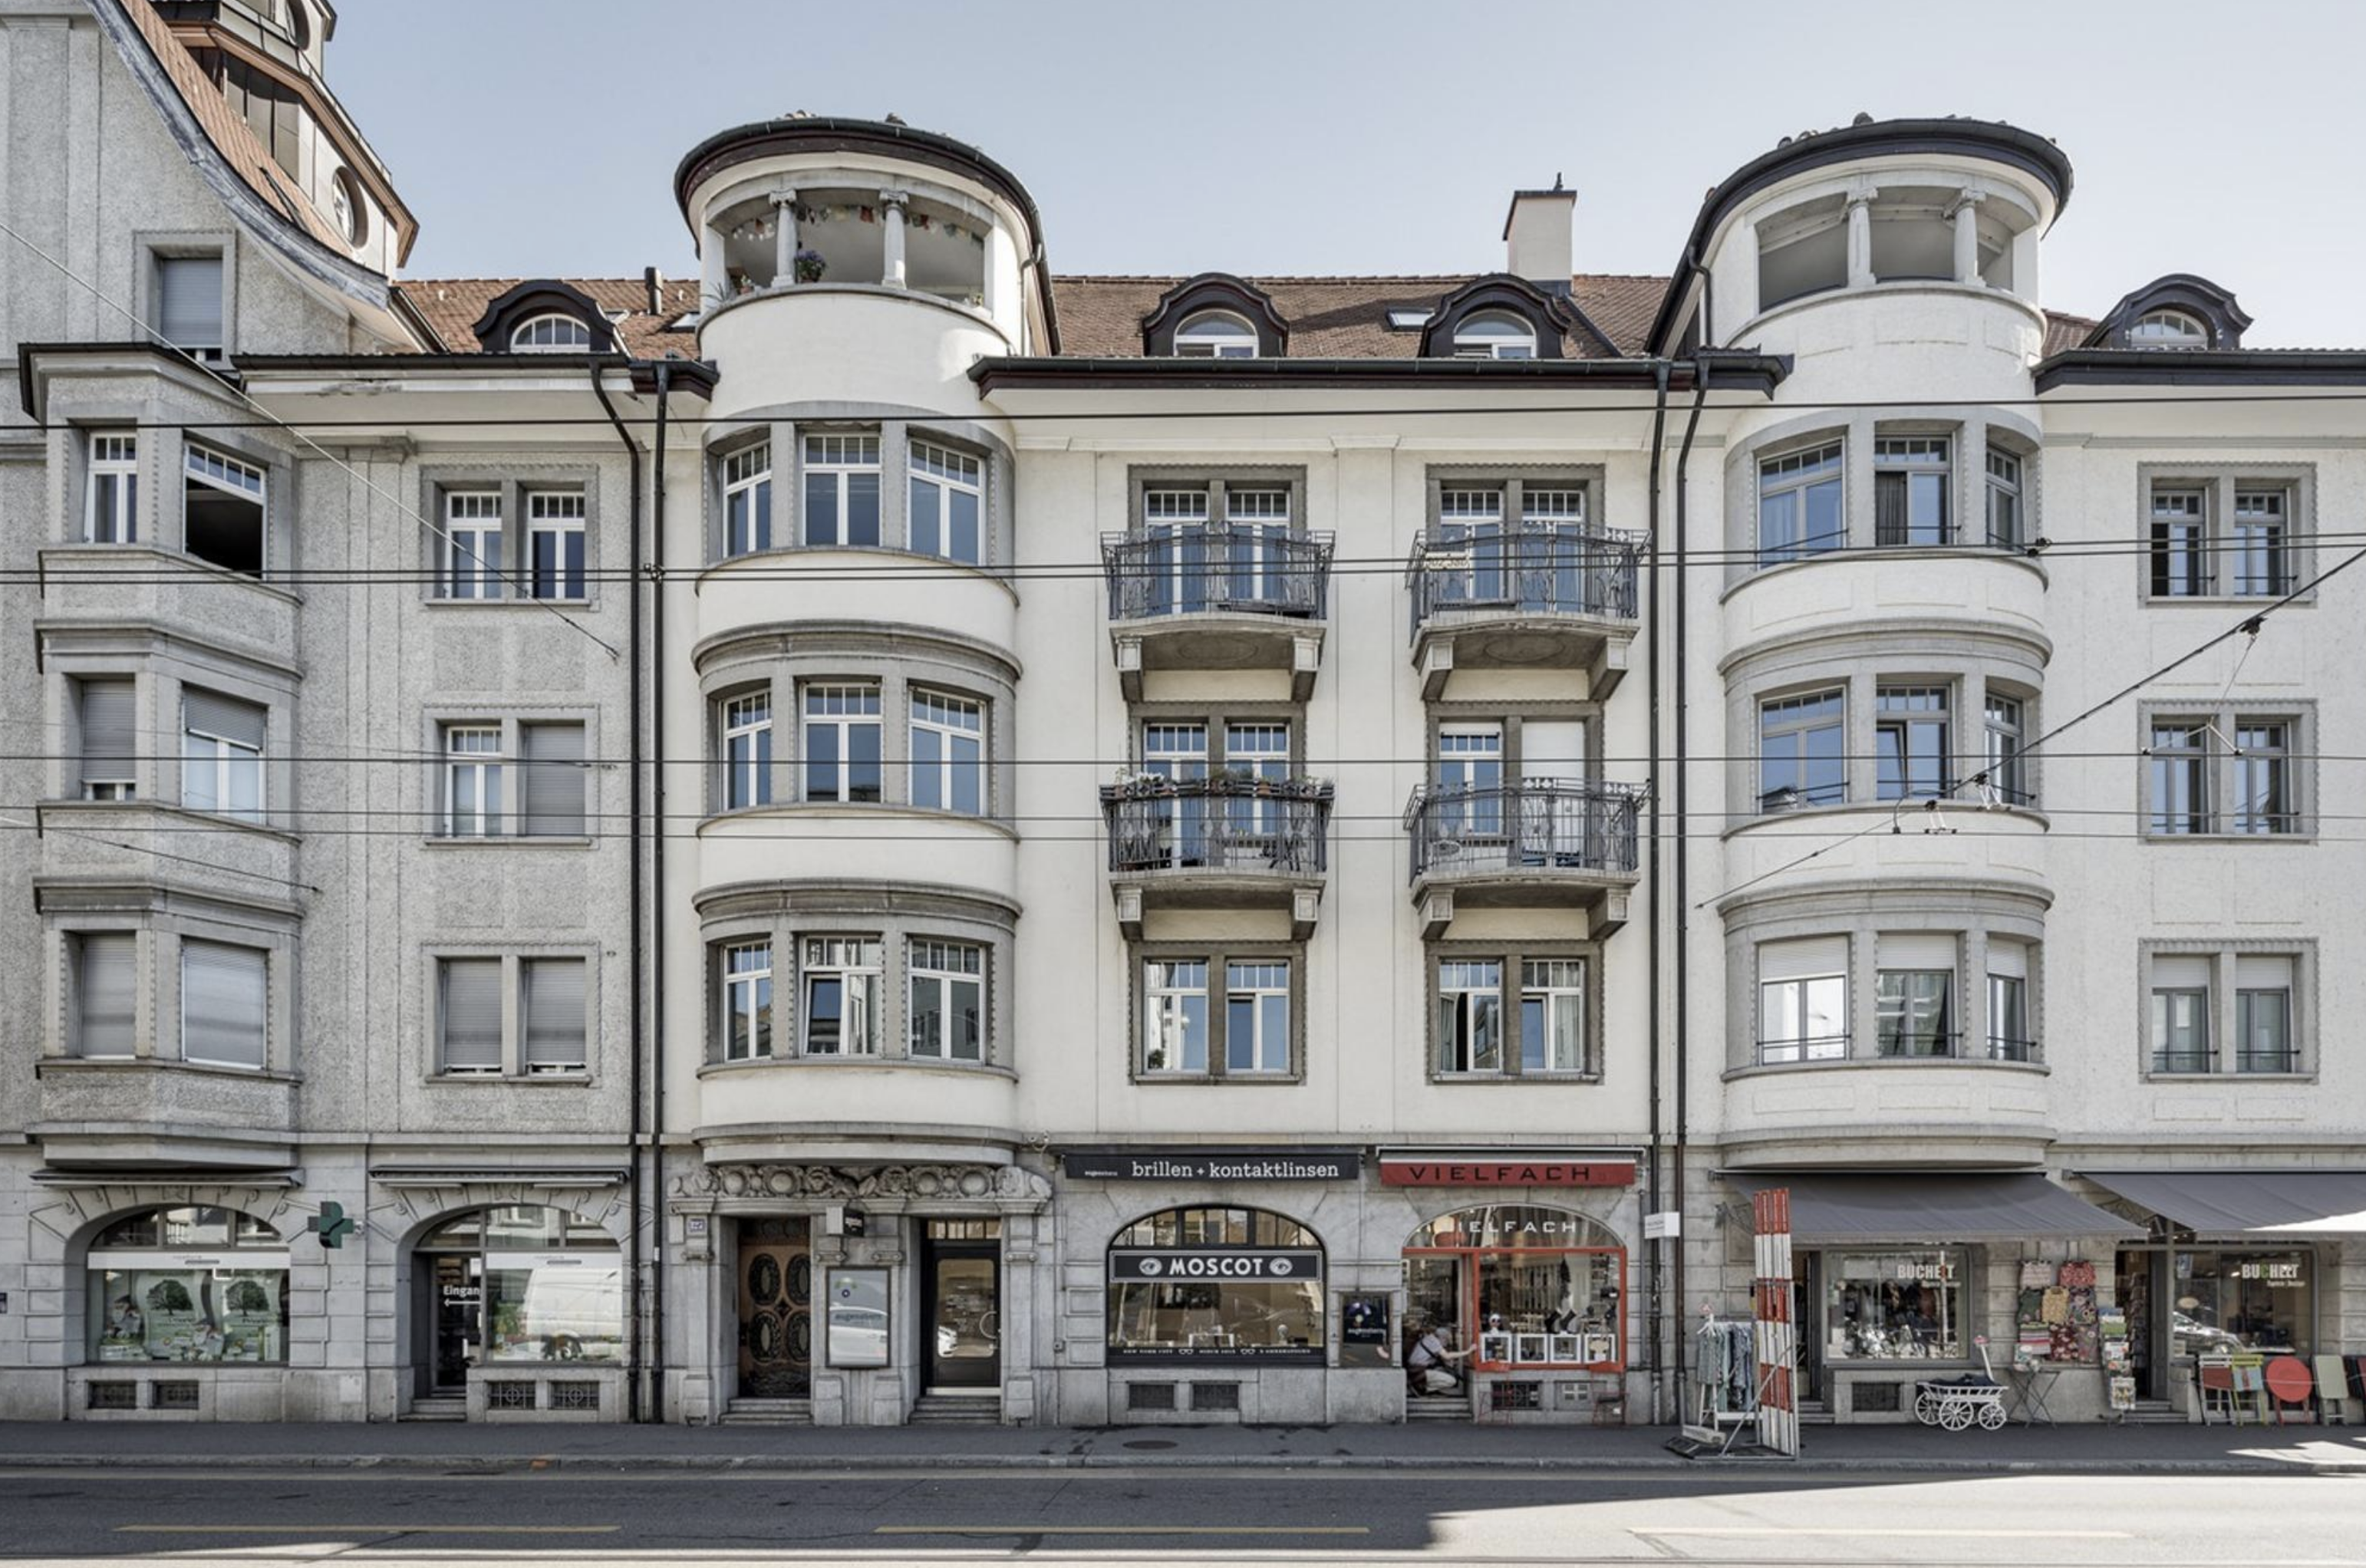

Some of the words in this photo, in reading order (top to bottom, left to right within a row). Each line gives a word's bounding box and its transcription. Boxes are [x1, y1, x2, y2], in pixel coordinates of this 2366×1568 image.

[1132, 1161, 1193, 1177] brillen
[1197, 1167, 1205, 1176] +
[1209, 1161, 1339, 1178] kontaktlinsen
[1409, 1167, 1590, 1181] VIELFACH
[1439, 1221, 1577, 1233] IELFACH
[1169, 1258, 1264, 1276] MOSCOT
